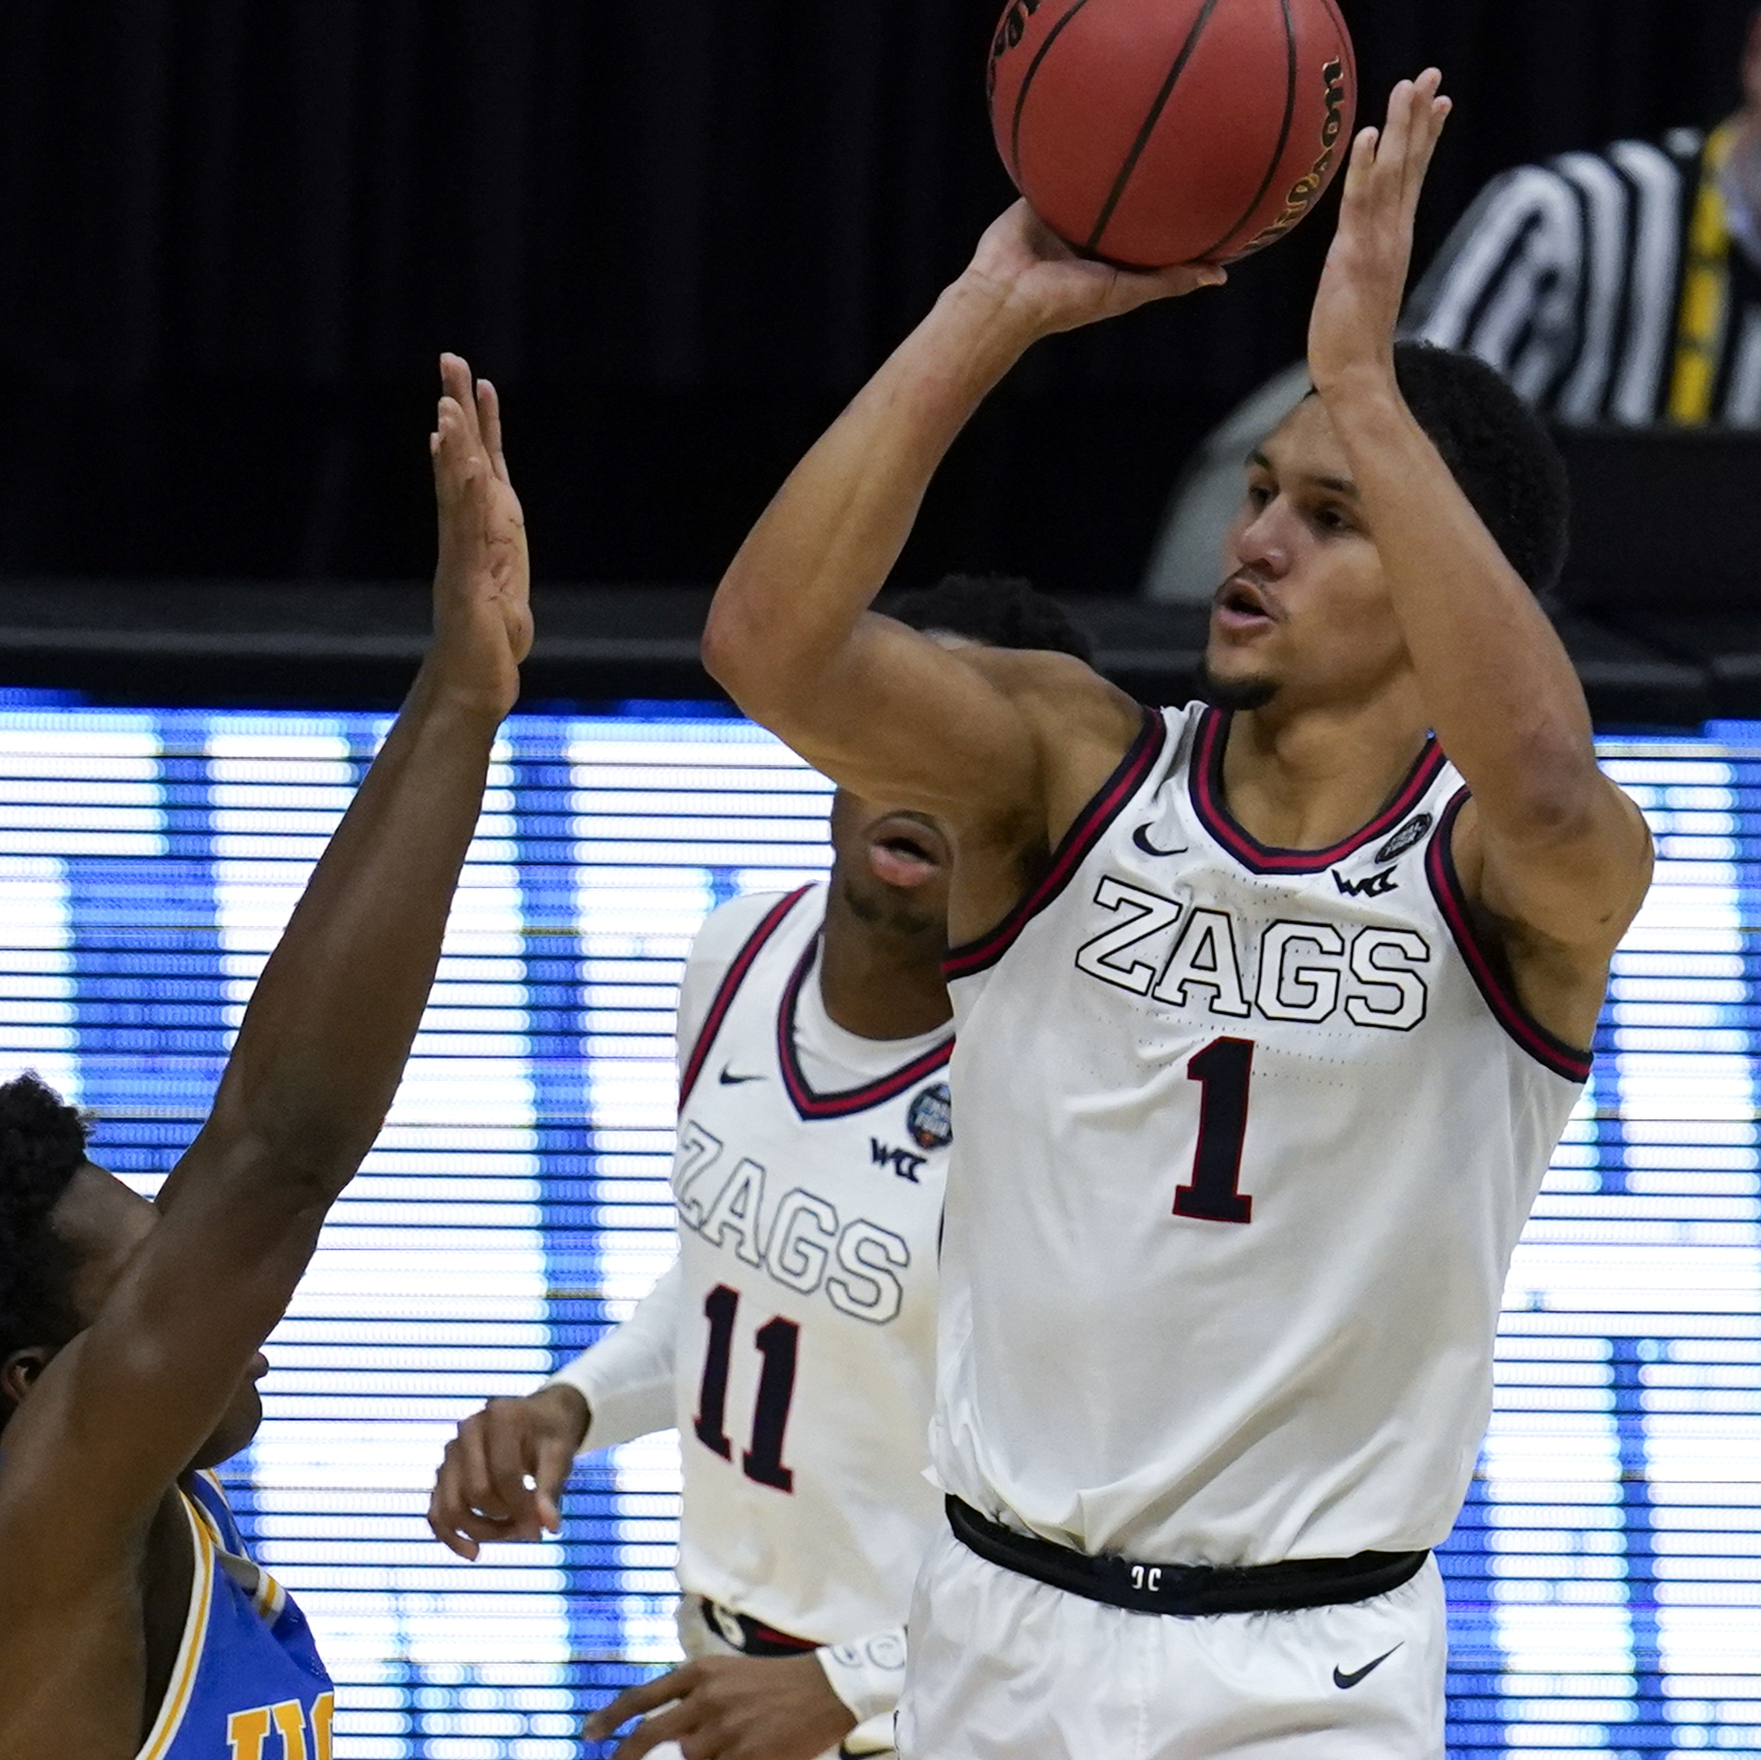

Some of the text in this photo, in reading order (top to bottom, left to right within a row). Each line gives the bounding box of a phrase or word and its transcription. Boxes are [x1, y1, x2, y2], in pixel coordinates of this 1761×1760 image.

[1075, 874, 1431, 1032] ZAGS
[674, 1120, 911, 1326] ZAGS
[1172, 1035, 1255, 1224] 1
[692, 1283, 801, 1496] 11
